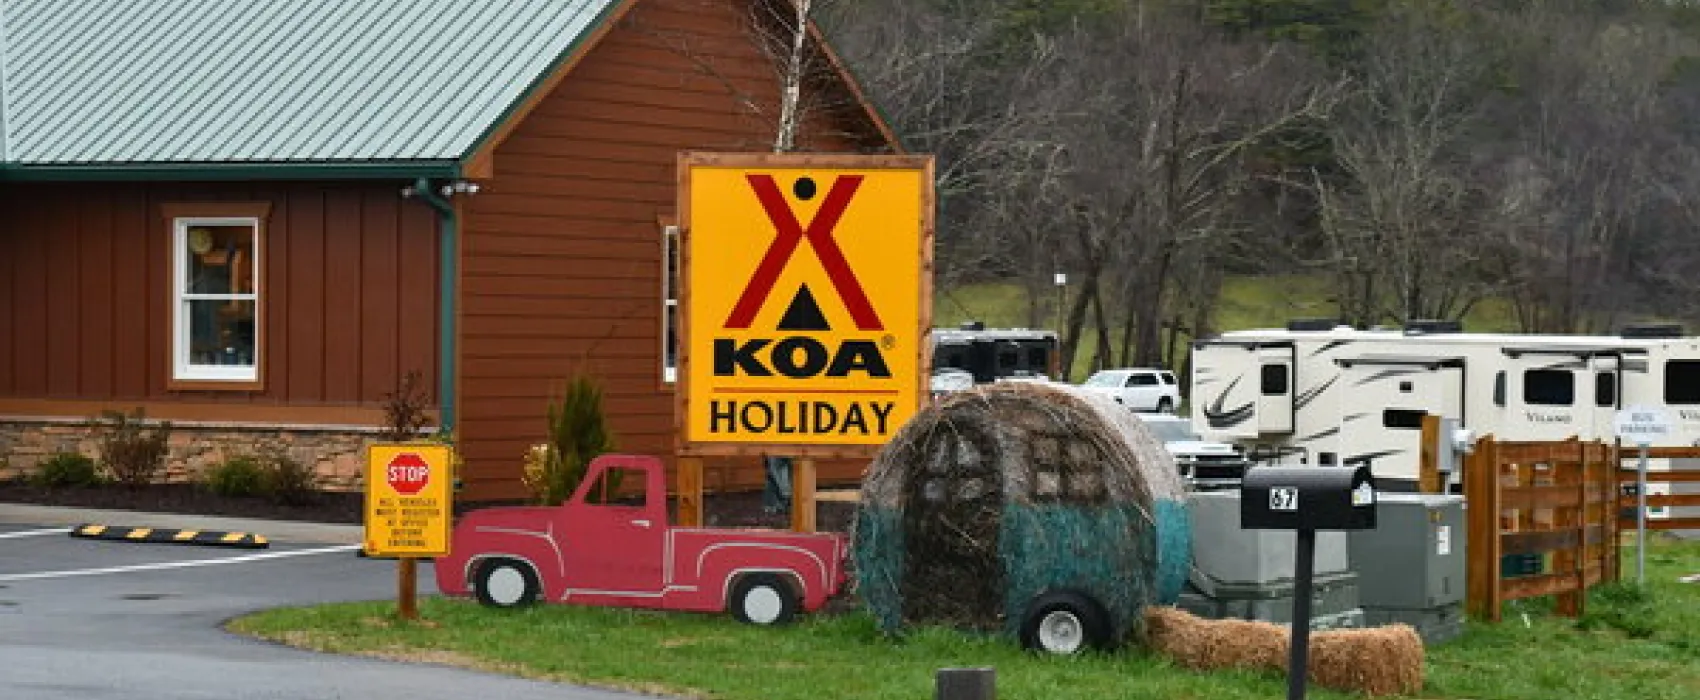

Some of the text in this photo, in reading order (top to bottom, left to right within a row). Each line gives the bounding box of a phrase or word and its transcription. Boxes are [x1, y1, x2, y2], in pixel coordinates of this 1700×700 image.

[713, 336, 892, 379] KOA
[710, 400, 895, 434] HOLIDAY
[389, 465, 429, 482] STOP
